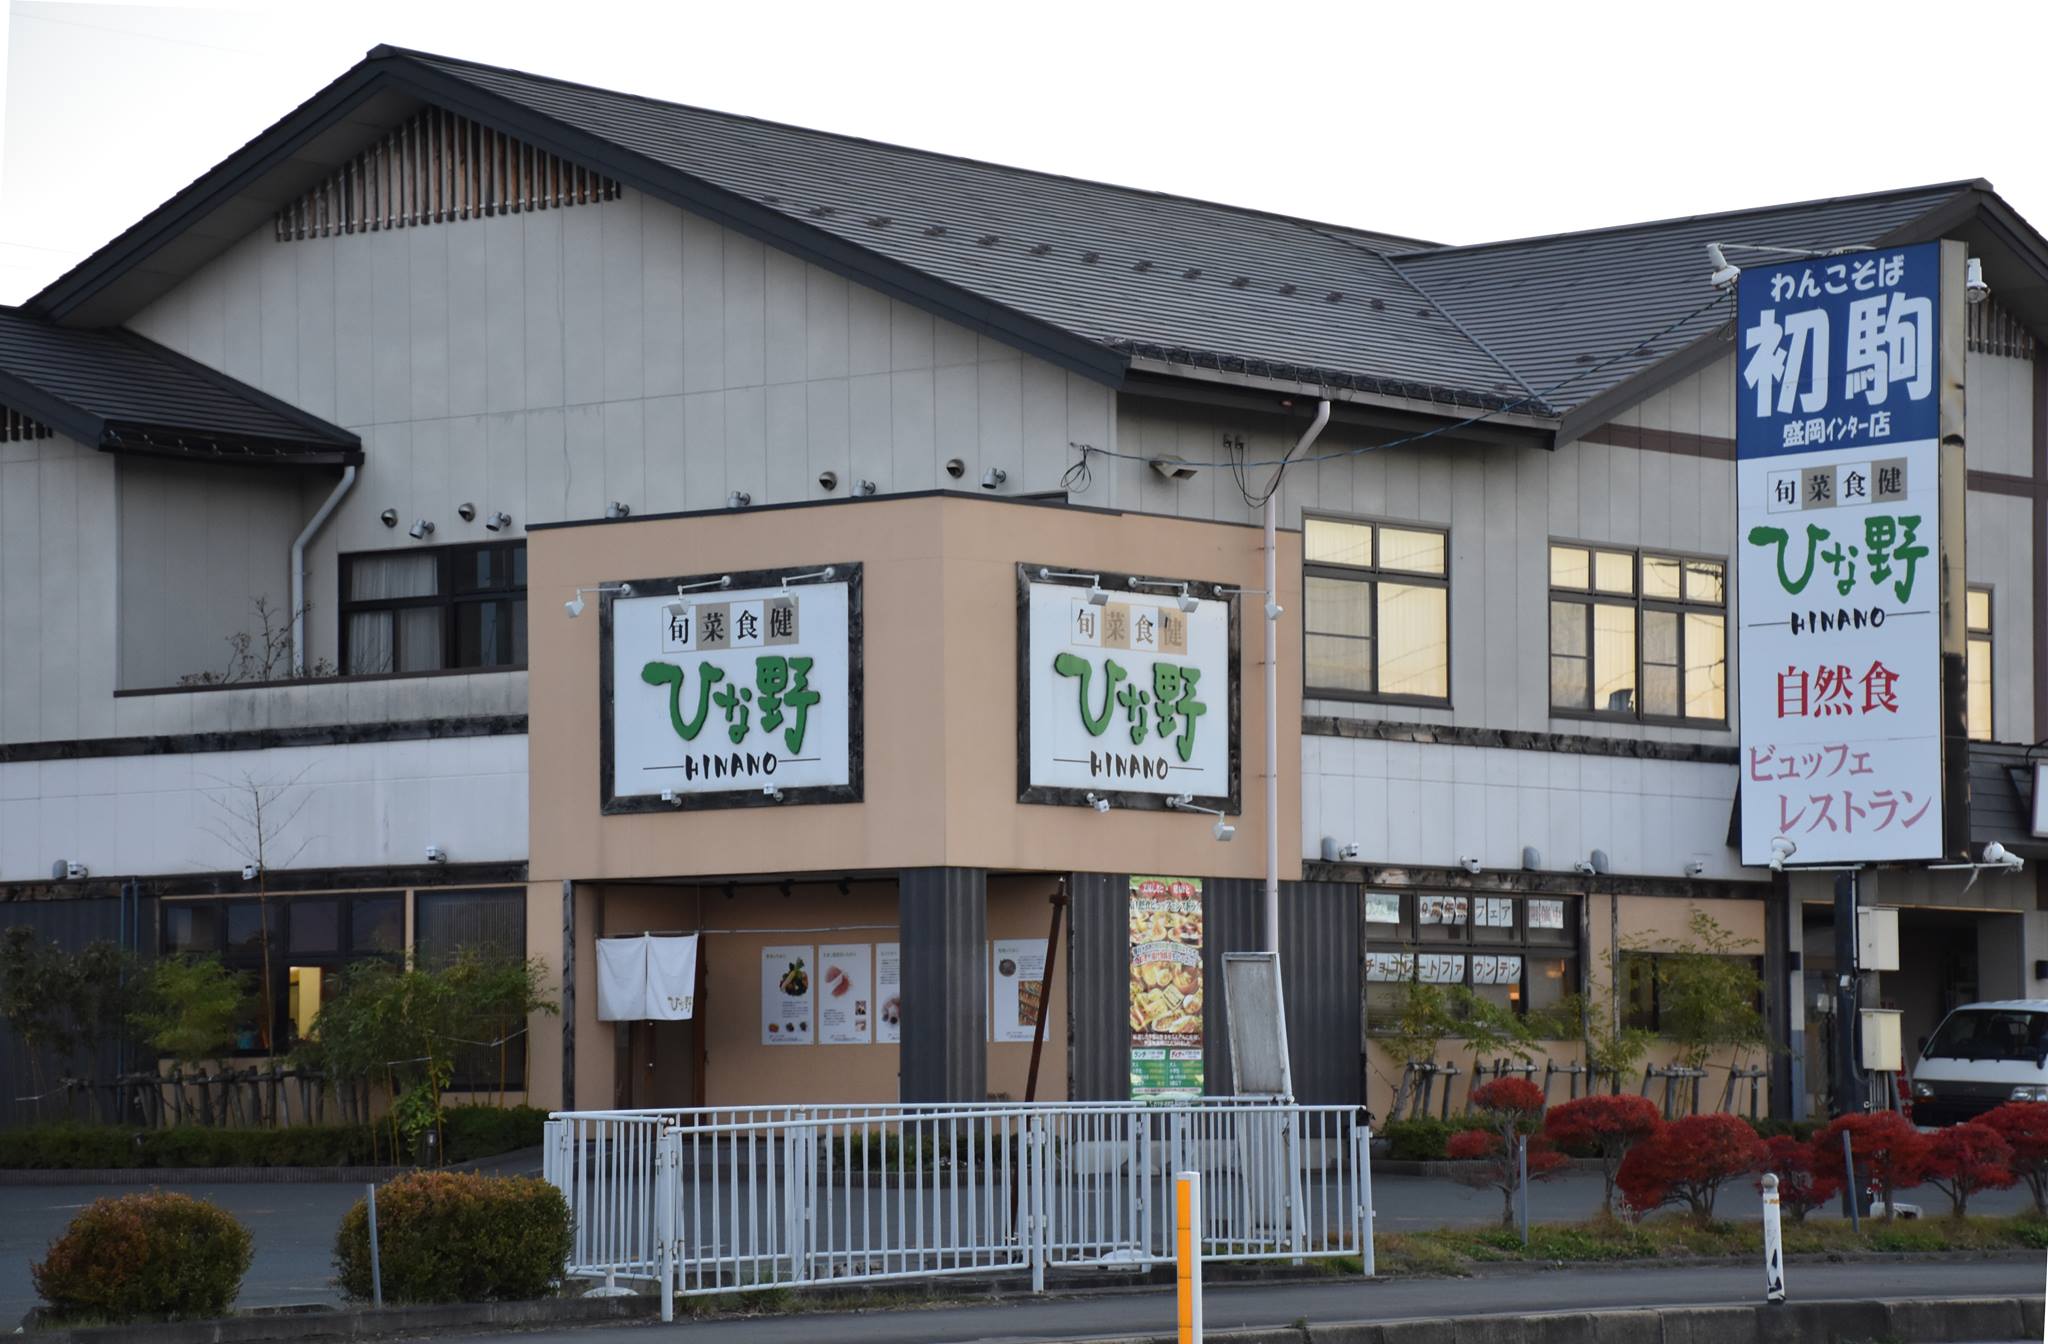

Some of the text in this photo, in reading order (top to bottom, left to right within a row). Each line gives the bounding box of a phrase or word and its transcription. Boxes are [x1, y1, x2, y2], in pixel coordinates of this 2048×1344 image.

[1771, 254, 1905, 302] わんこそば
[1743, 291, 1933, 418] 初駒
[1782, 411, 1892, 448] 盛岡インター店
[1774, 466, 1902, 505] 旬菜食健
[1748, 515, 1929, 604] ひな野
[667, 608, 794, 645] 旬菜食健
[1076, 607, 1183, 648] 旬菜食健
[1791, 606, 1886, 636] HINANO
[641, 655, 821, 755] ひな野
[1054, 652, 1207, 762] ひな野
[1777, 660, 1900, 718] 自然食
[685, 752, 778, 781] HINANO
[1090, 751, 1169, 780] HINANO
[1750, 743, 1874, 782] ビュッフェ
[1778, 790, 1932, 834] レストラン
[1475, 905, 1511, 920] フェア
